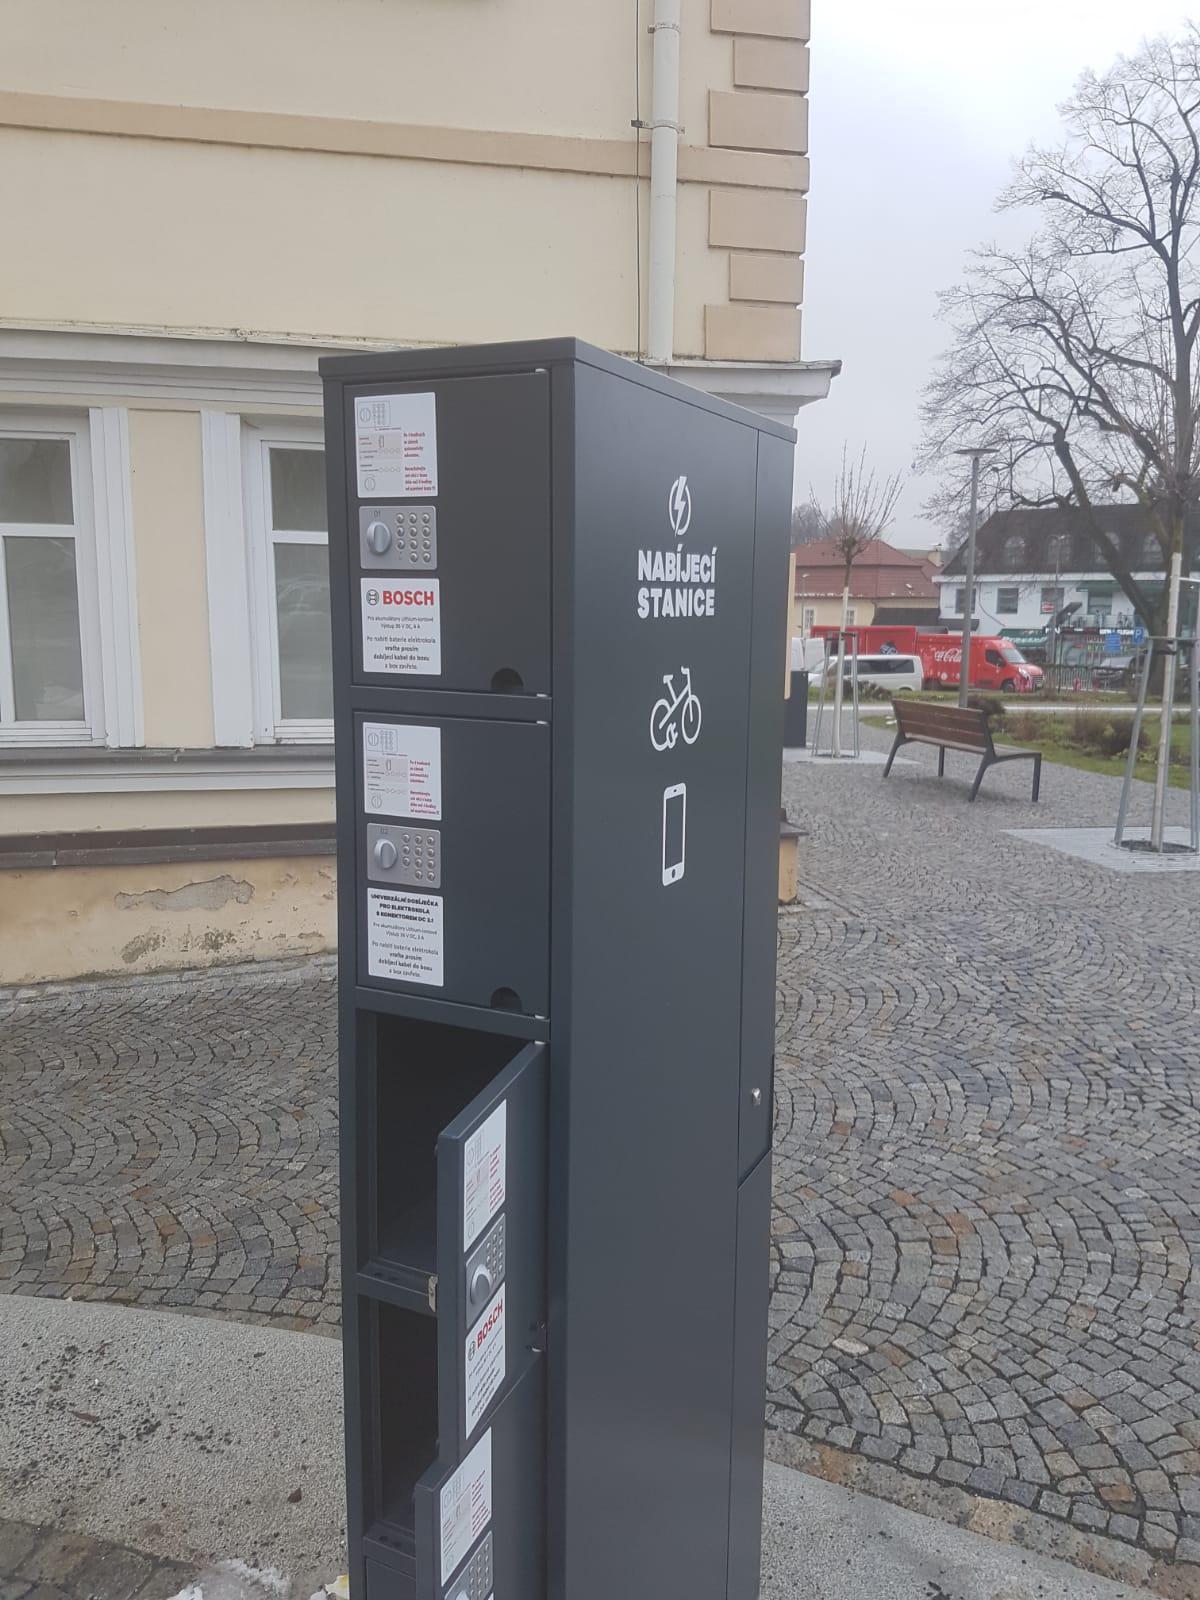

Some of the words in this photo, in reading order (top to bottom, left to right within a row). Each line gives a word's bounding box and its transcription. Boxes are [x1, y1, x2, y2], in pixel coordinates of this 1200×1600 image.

[637, 543, 718, 584] NABÍJECÍ
[382, 590, 435, 606] BOSCH
[637, 586, 716, 619] STANICE
[381, 912, 418, 920] KONEKTOREM
[391, 904, 430, 914] ELEKTROKOLA
[476, 1299, 504, 1350] BOSCH
